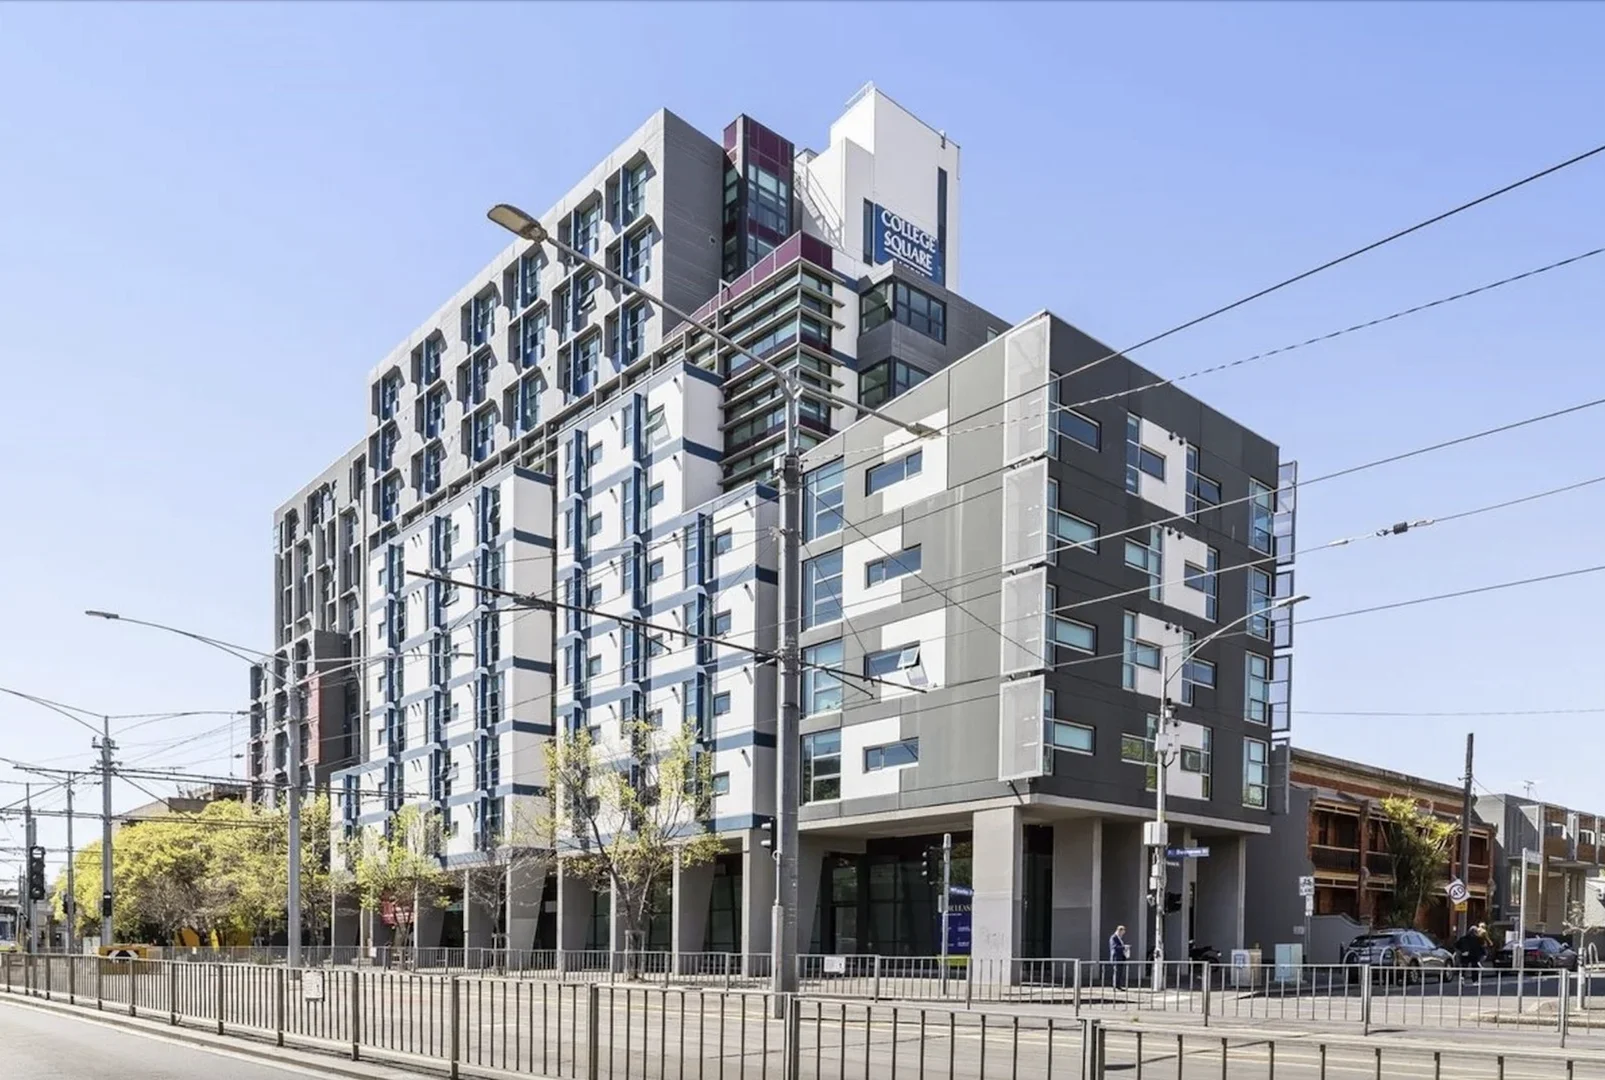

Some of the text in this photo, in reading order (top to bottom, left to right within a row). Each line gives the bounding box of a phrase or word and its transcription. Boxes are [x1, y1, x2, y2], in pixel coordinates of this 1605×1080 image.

[881, 210, 936, 253] COLLEGE
[884, 231, 933, 270] SQUARE
[1452, 886, 1465, 897] 40
[954, 904, 972, 912] LEAS
